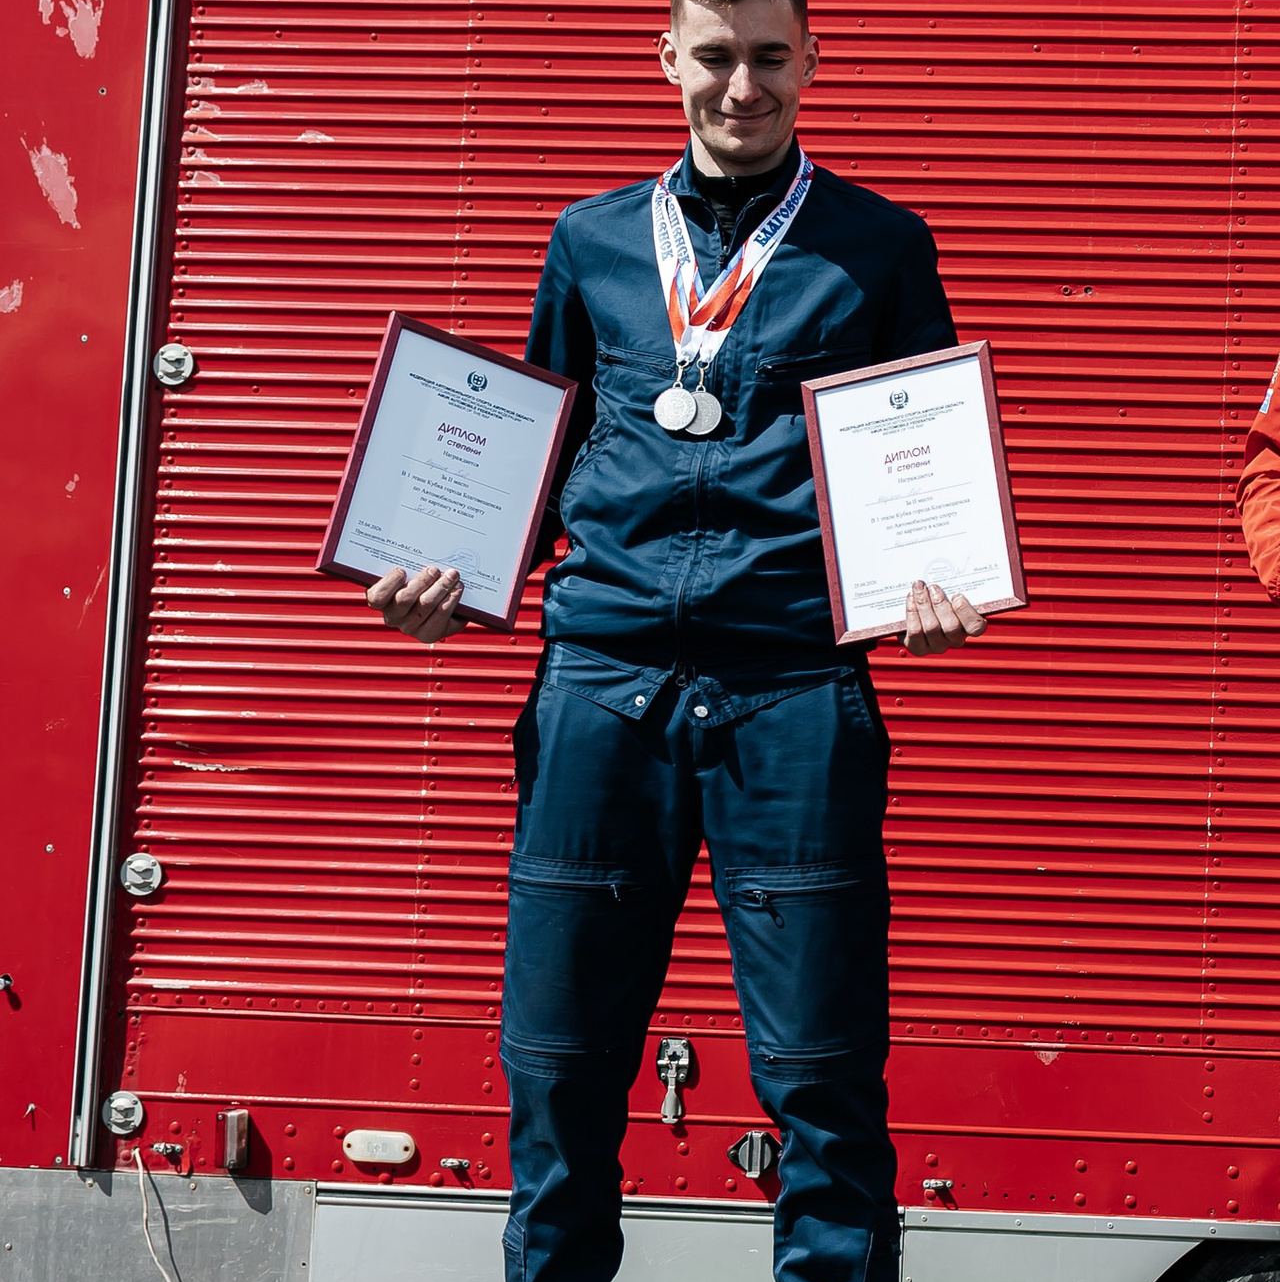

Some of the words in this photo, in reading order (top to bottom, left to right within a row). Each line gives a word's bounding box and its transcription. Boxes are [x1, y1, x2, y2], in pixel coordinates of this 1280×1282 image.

[437, 421, 486, 447] ДИПЛОМ
[437, 434, 443, 442] II
[446, 438, 481, 456] степени
[883, 444, 930, 464] ДИПЛОМ
[896, 458, 930, 472] степени
